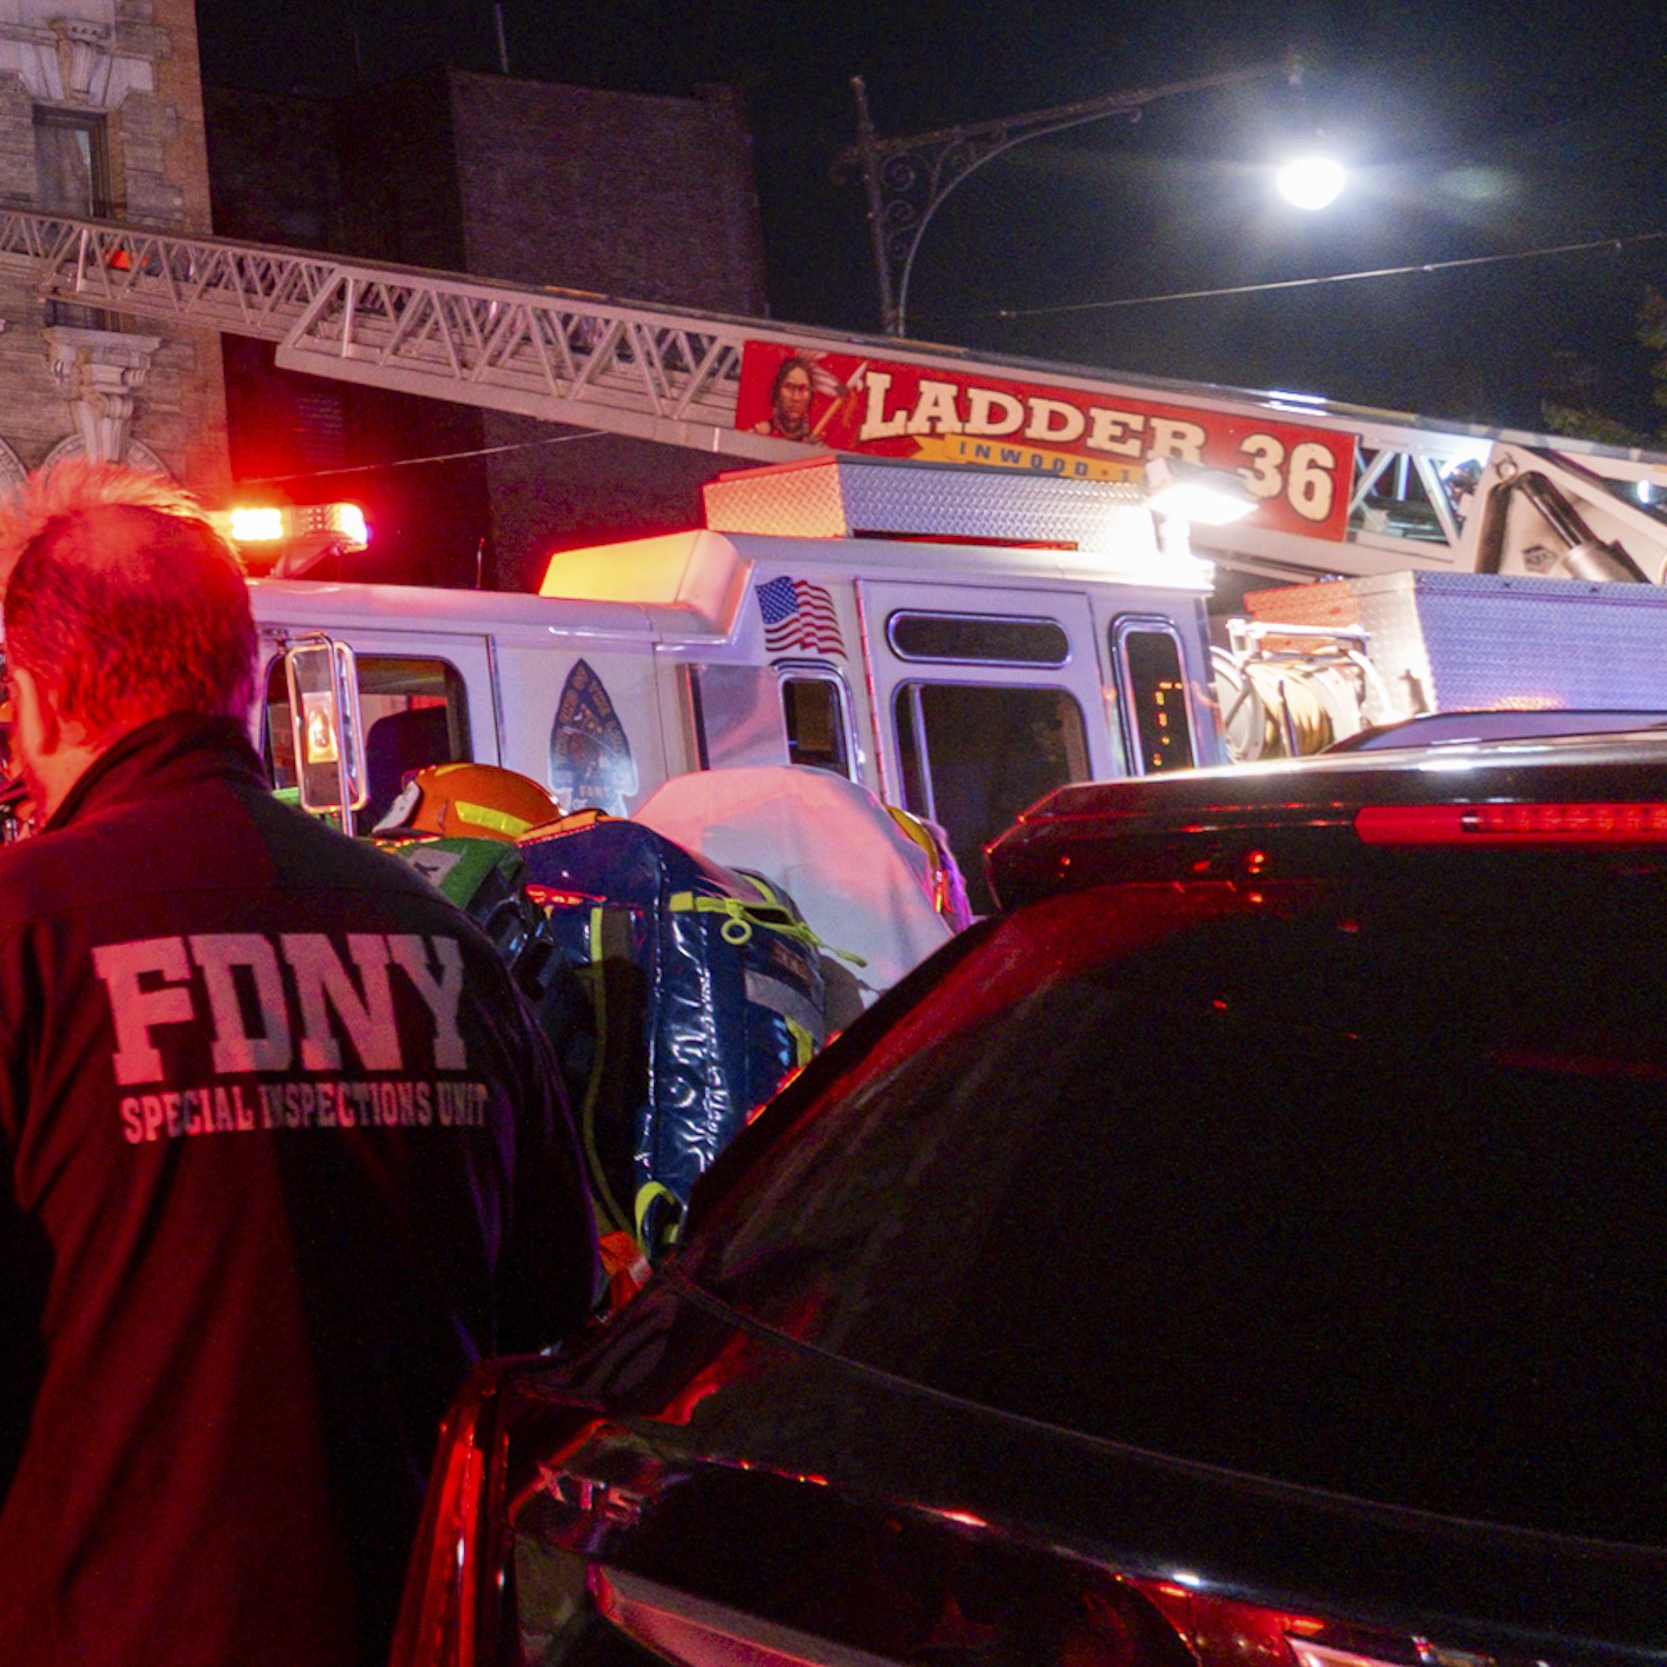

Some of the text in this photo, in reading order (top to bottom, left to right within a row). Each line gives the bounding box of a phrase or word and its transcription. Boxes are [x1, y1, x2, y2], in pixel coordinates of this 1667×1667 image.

[859, 370, 1335, 522] LADDER 36
[959, 441, 1088, 477] INWOOD
[92, 933, 469, 1087] FDNY
[120, 1080, 489, 1145] SPECIAL INSPECTIONS UNIT
